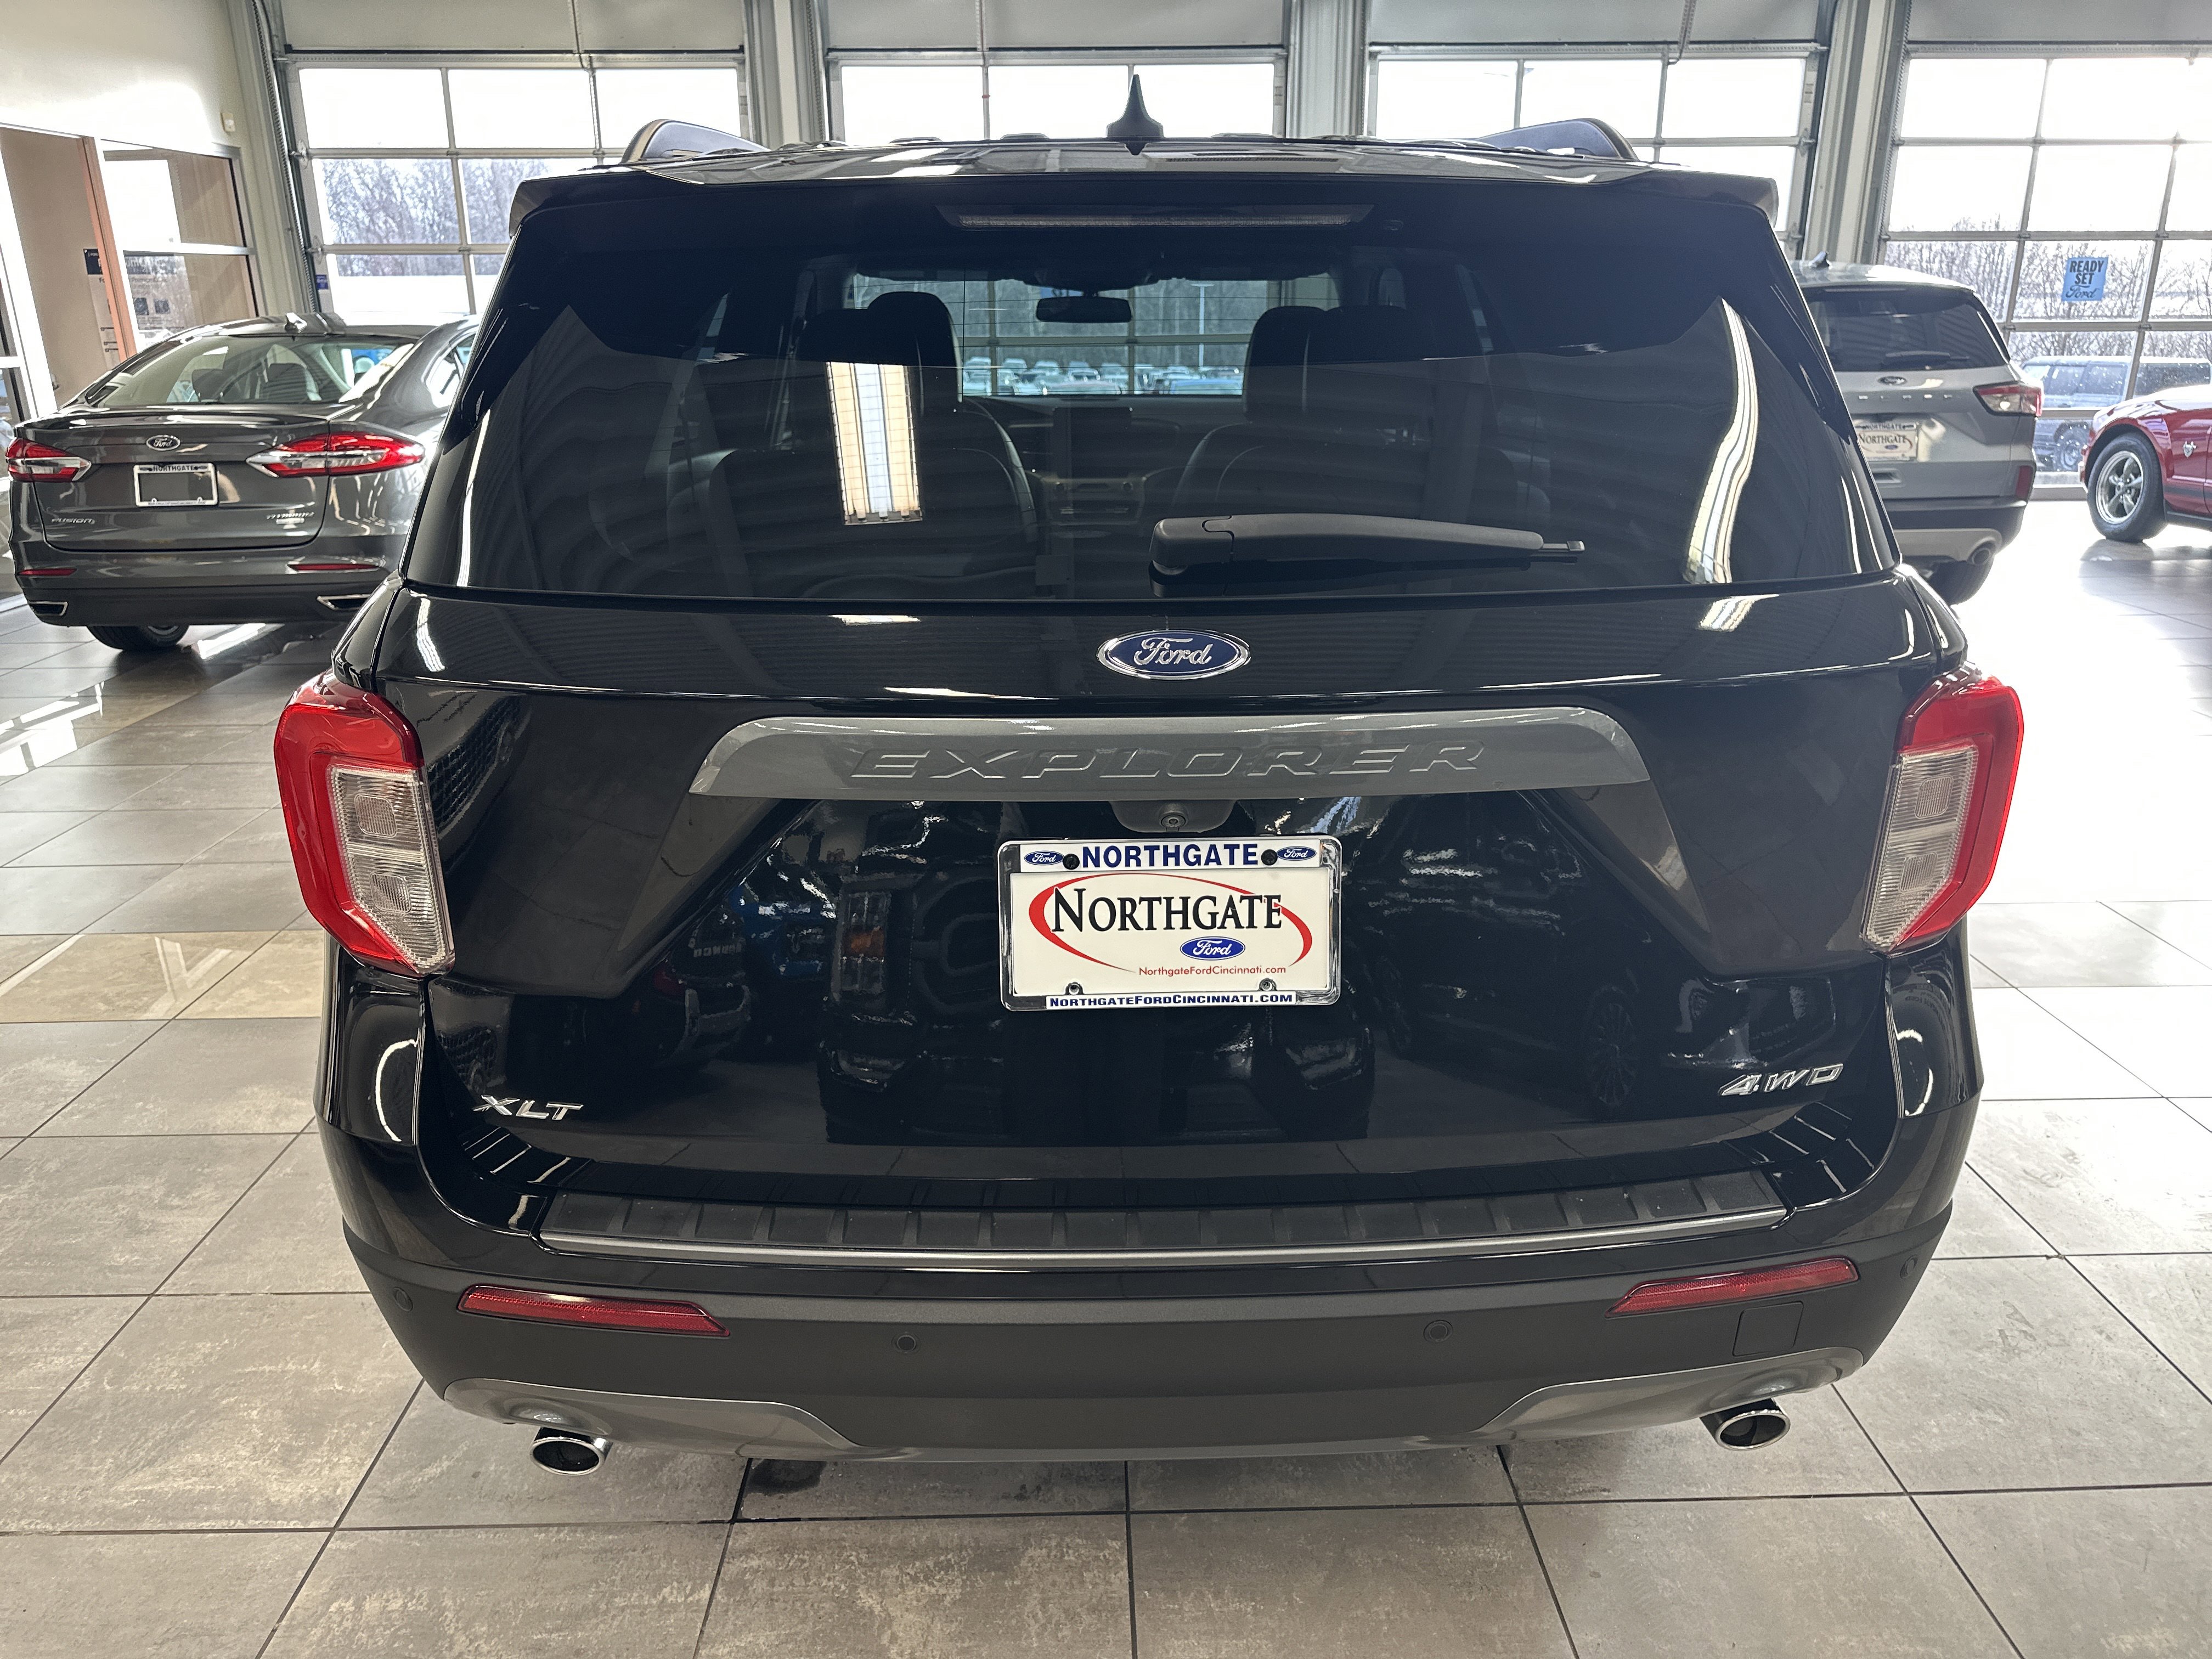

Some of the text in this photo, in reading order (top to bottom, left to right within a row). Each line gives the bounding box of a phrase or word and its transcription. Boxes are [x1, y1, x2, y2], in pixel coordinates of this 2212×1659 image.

[2069, 260, 2104, 273] READY
[2074, 273, 2095, 285] SET
[2066, 285, 2100, 298] Ford
[153, 438, 173, 447] Ford
[1133, 637, 1214, 665] Ford
[850, 741, 1485, 778] EXPLORER
[1032, 844, 1309, 868] Ford NORTHGATE Ford
[1051, 887, 1283, 933] NORTHGATE
[1192, 939, 1233, 956] Ford
[1138, 964, 1286, 977] NorthgateFordCincinnati.com
[1718, 1063, 1844, 1096] 4WD
[472, 1094, 584, 1120] XLT
